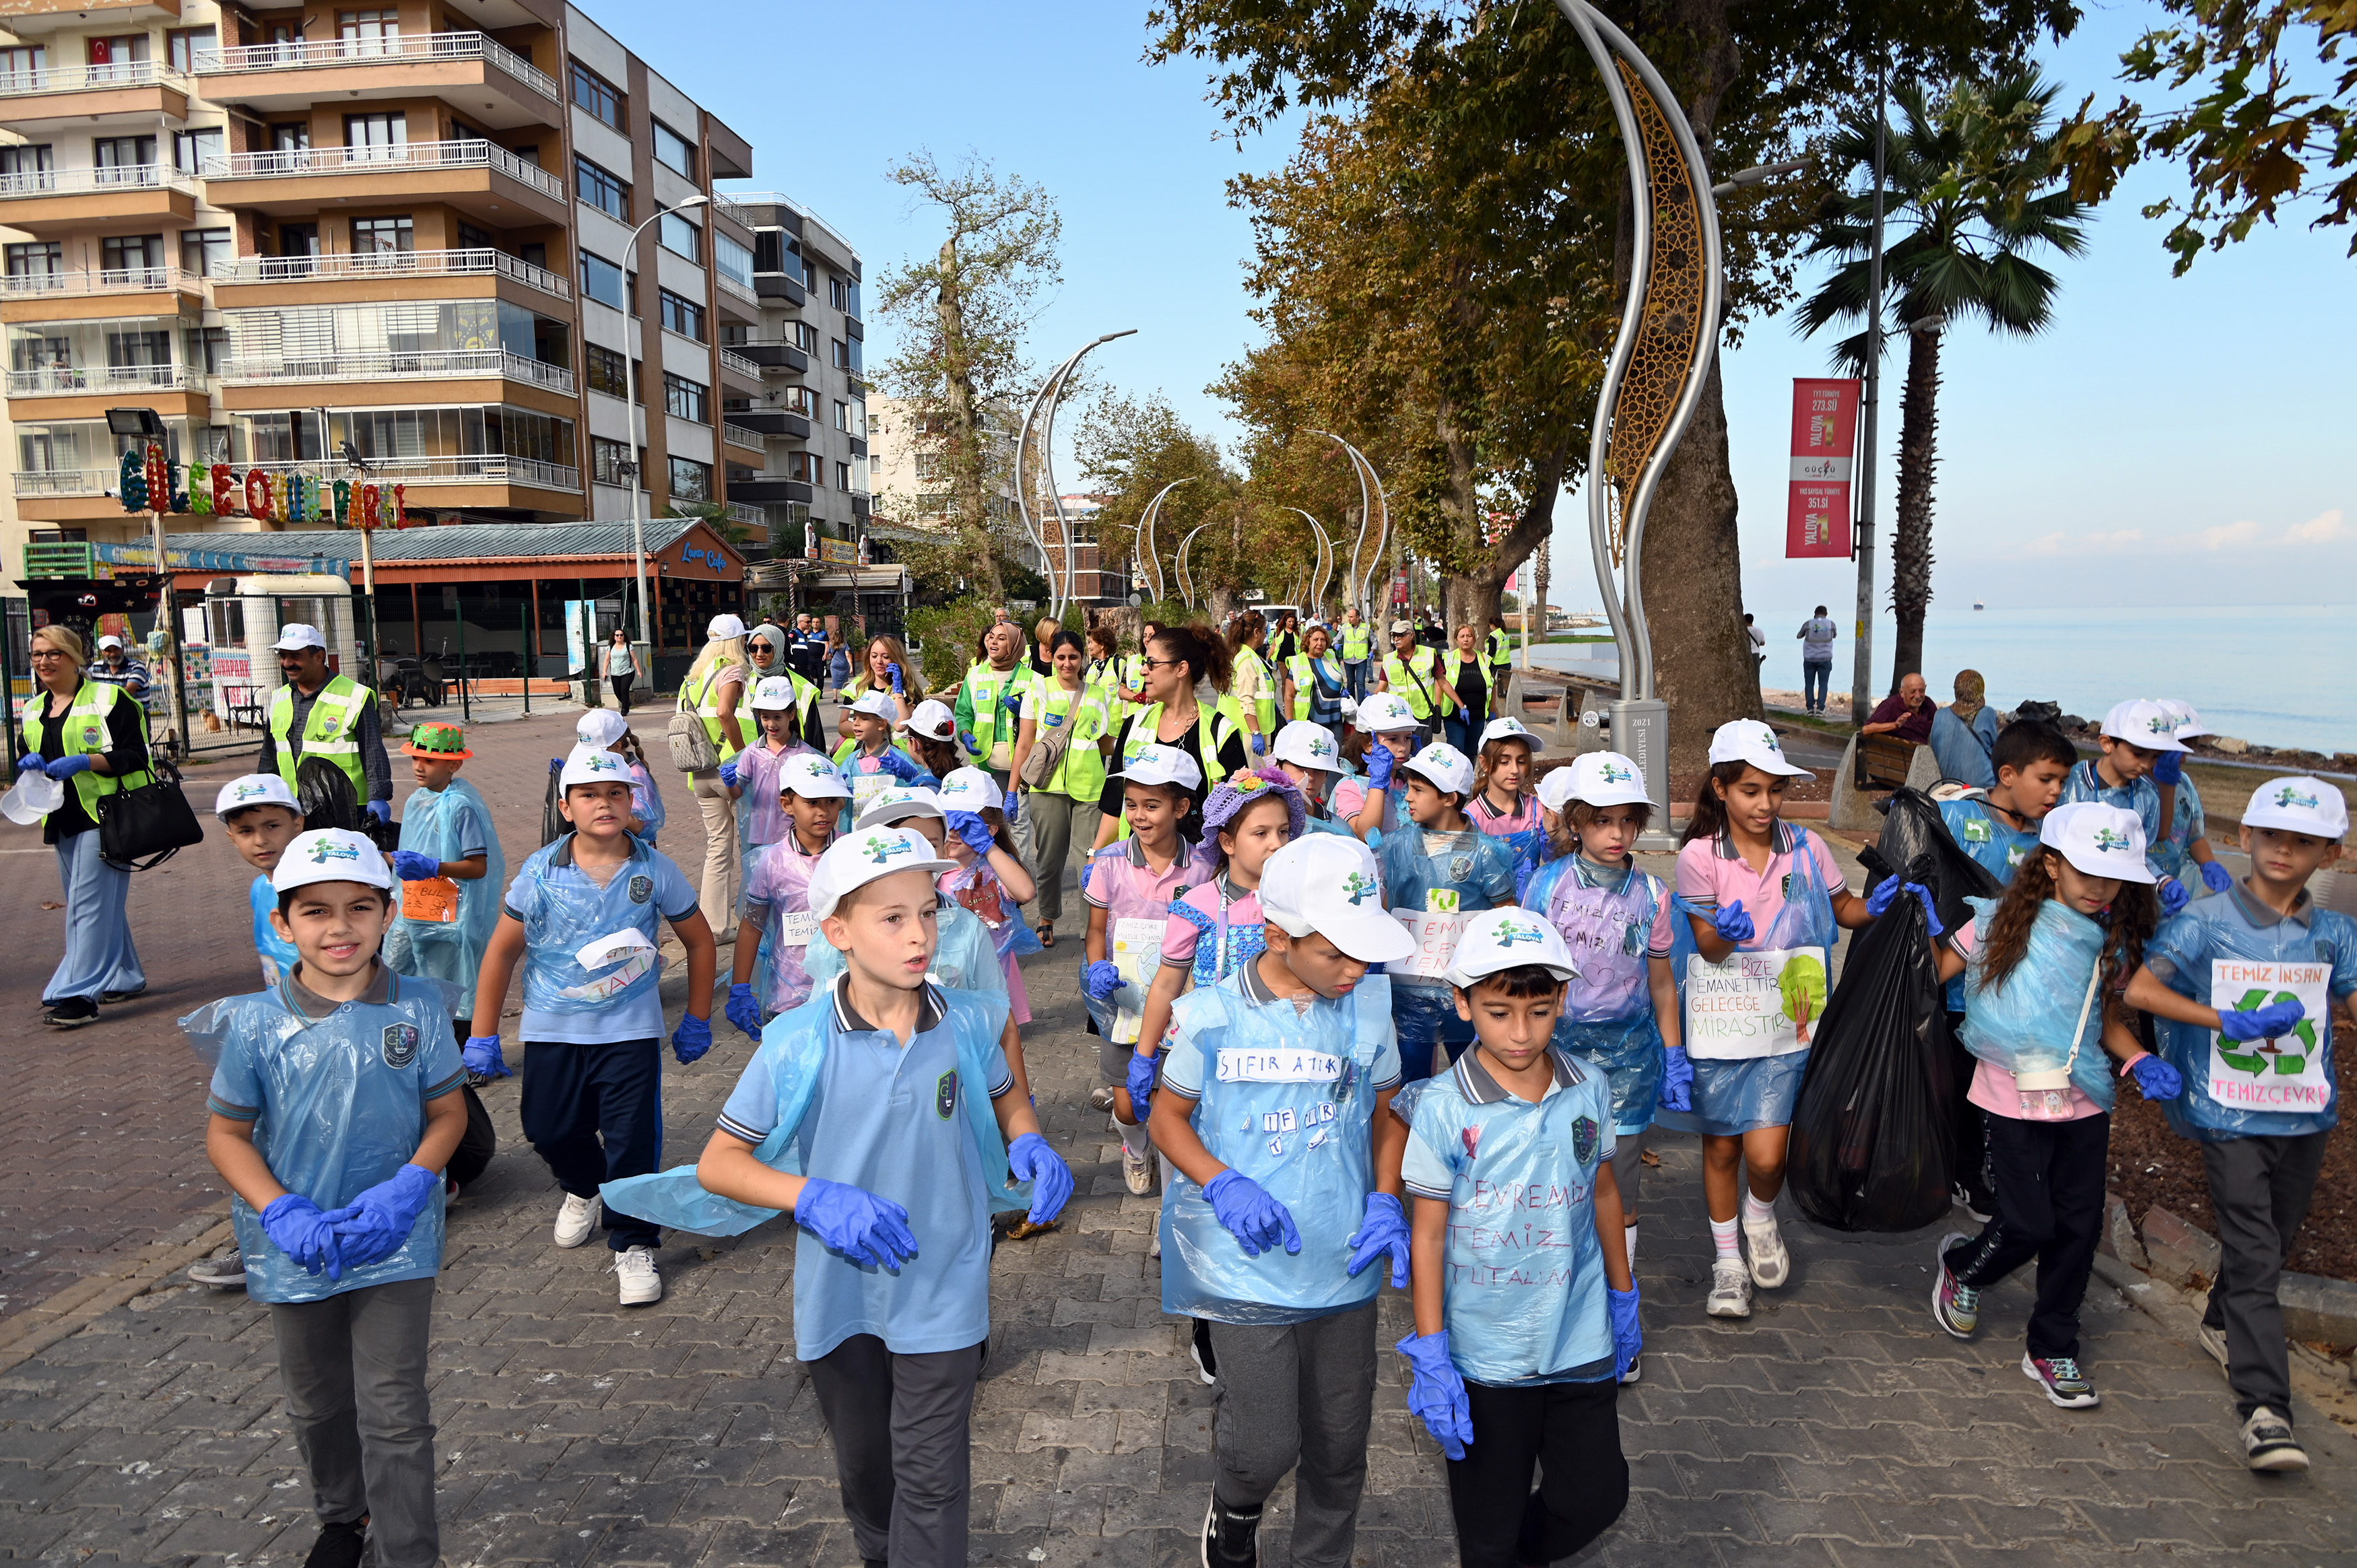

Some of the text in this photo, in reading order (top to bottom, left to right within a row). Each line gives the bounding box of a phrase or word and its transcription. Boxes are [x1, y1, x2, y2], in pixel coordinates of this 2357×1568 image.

[1812, 399, 1837, 411] 273.SÜ
[1810, 415, 1823, 447] YALOVA
[244, 468, 323, 523] OYUN
[331, 479, 409, 531] PARKI
[1808, 496, 1828, 508] 351.Sİ
[1805, 513, 1818, 545] YALOVA
[681, 541, 727, 573] Luna Cafe
[835, 552, 854, 561] RESTAURANT
[213, 658, 251, 678] LUNAPARK
[1632, 718, 1651, 727] 2021
[327, 850, 356, 860] YALOVA
[884, 846, 910, 854] YALOVA
[1513, 934, 1540, 943] YALOVA
[1688, 955, 1773, 979] ÇEVRE BİZE
[2218, 963, 2323, 983] TEMİZ İNSAN
[1692, 994, 1760, 1013] GELECEĞE
[1690, 1013, 1790, 1037] MİRASTIR
[1220, 1054, 1280, 1077] SIFIR
[1447, 1223, 1571, 1250] TEMİZ
[1226, 1510, 1244, 1520] UNDER
